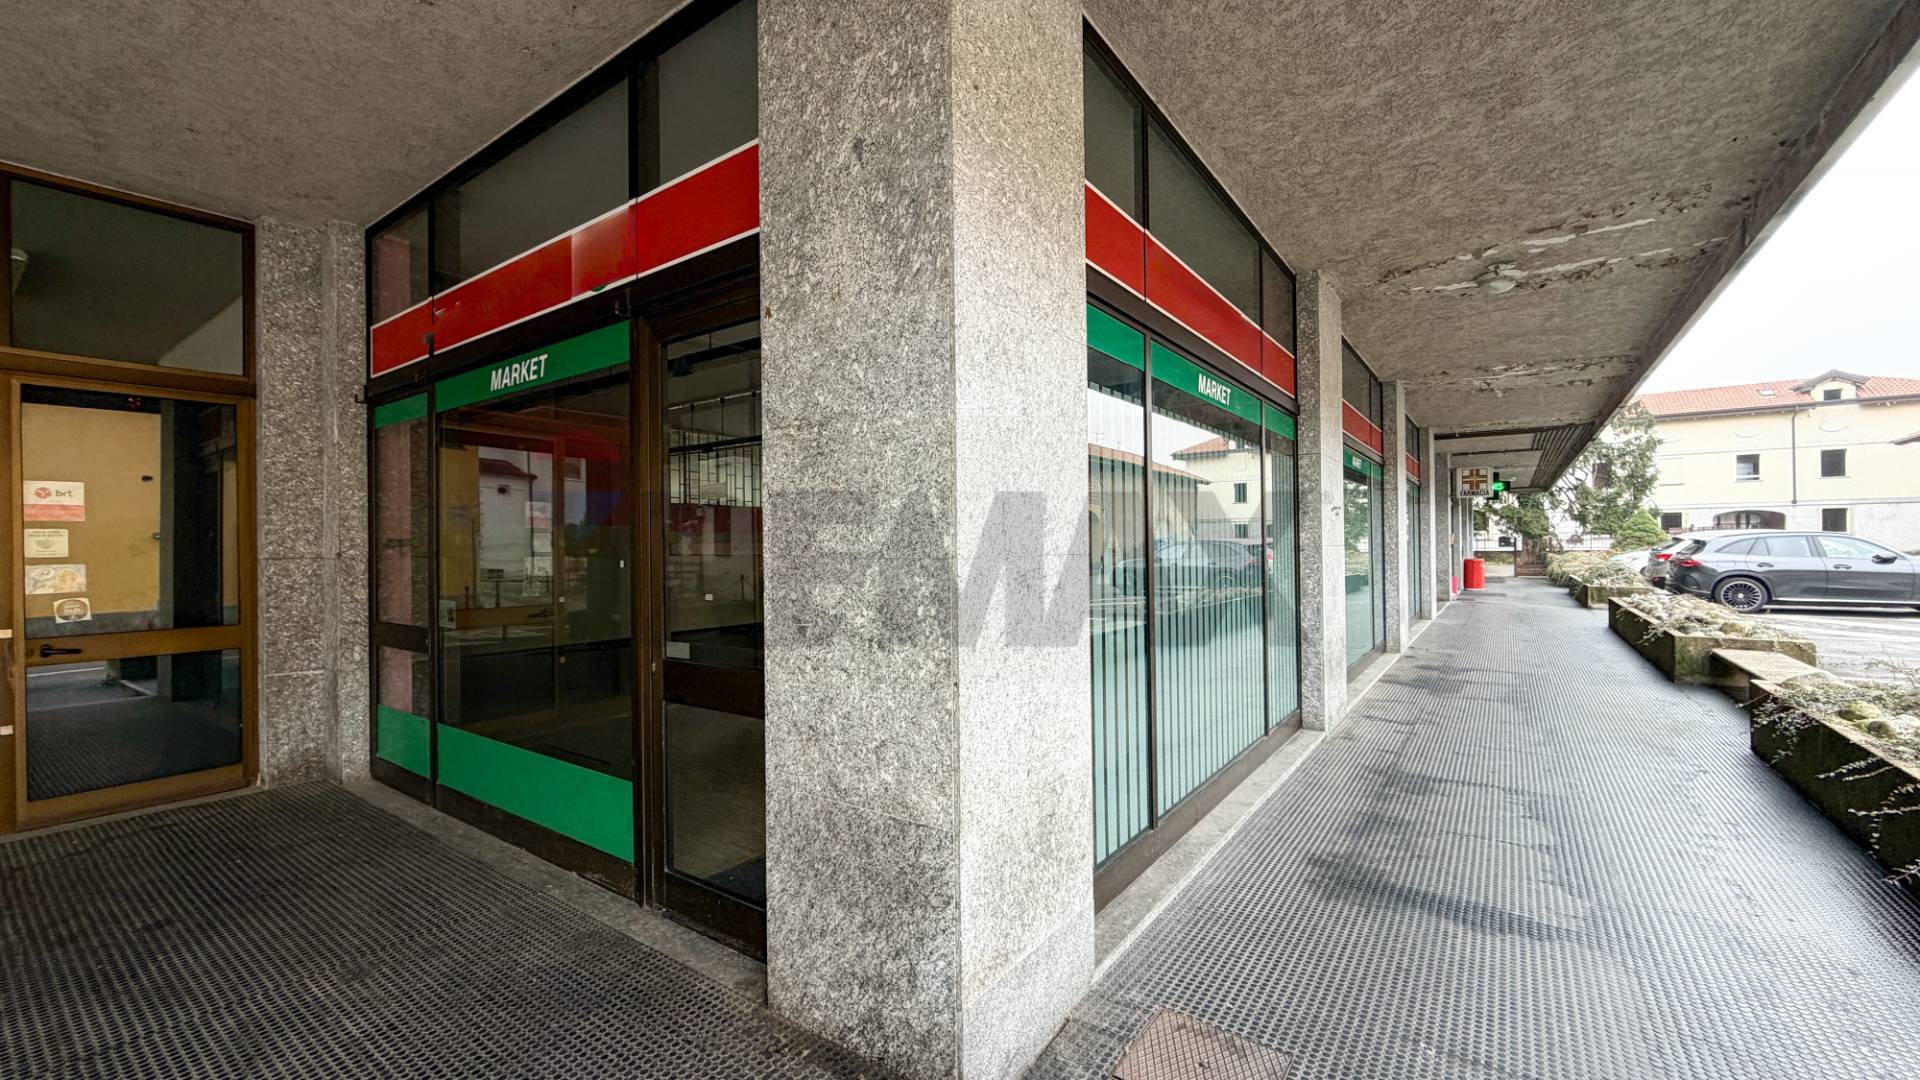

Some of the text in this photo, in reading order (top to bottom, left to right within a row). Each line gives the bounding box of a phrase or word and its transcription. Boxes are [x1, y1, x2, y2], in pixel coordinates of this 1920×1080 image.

[490, 353, 548, 392] MARKET
[1198, 373, 1231, 406] MARKET
[55, 489, 74, 498] brt
